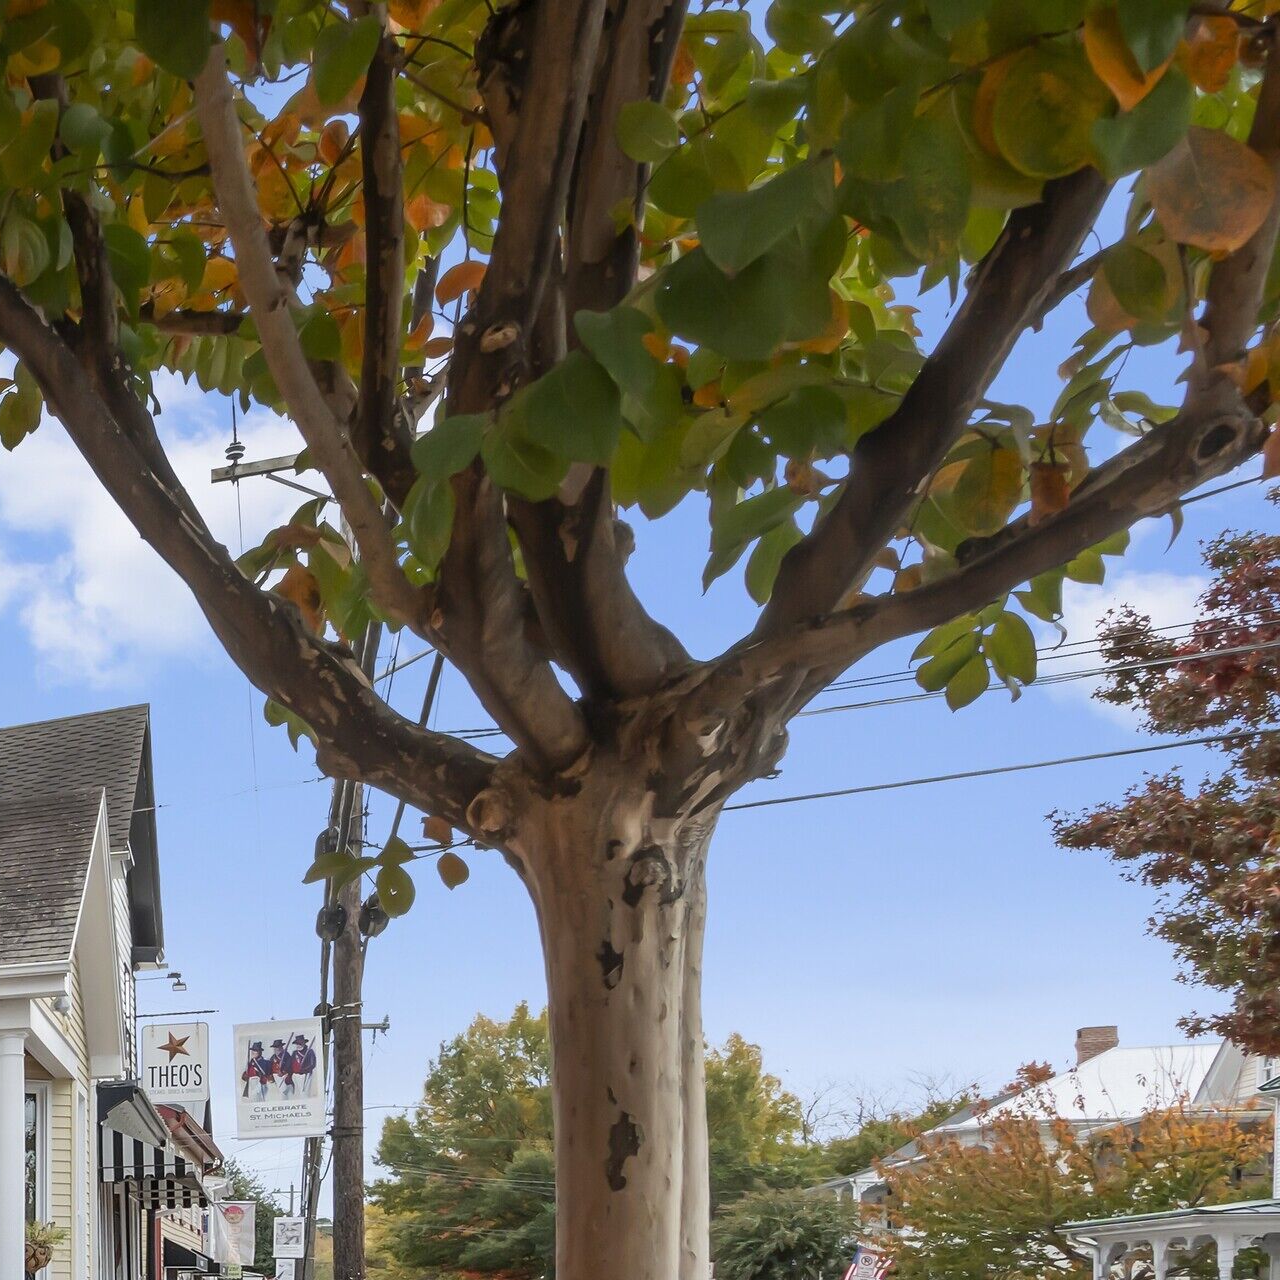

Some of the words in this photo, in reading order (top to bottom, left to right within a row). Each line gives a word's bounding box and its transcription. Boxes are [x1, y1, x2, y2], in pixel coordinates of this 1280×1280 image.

[147, 1063, 202, 1088] THEO'S
[253, 1104, 307, 1113] CELEBRATE
[264, 1111, 312, 1120] MICHAELS
